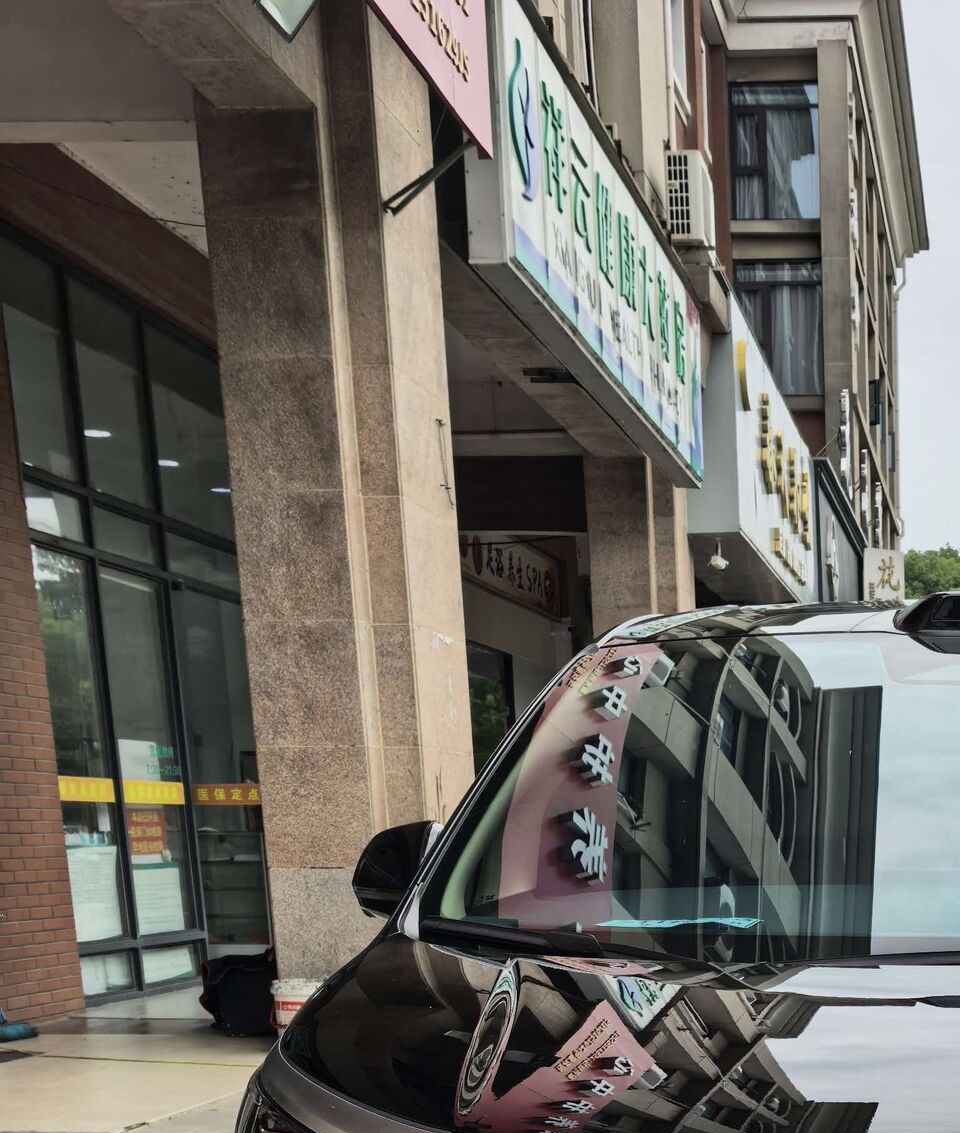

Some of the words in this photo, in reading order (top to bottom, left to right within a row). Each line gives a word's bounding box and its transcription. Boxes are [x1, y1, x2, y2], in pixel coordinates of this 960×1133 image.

[541, 80, 686, 385] 祥云健康大药房
[197, 787, 260, 801] 医保定点
